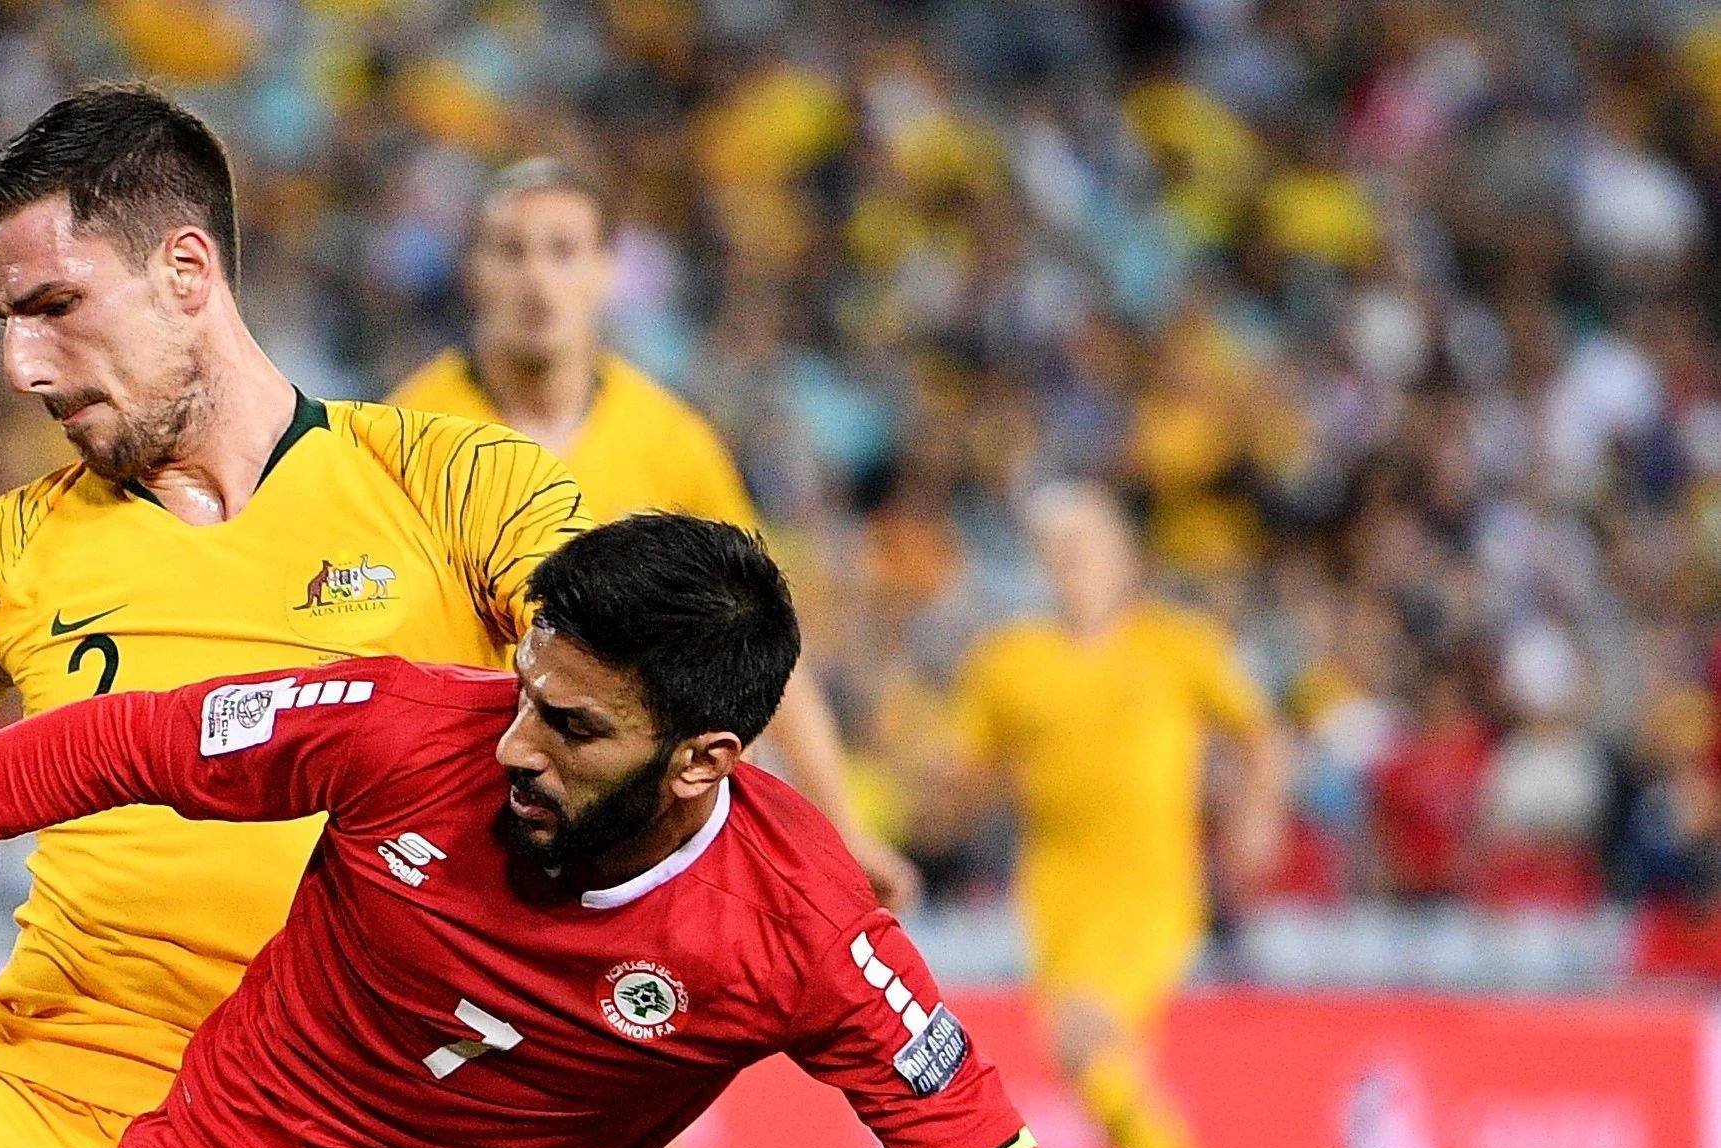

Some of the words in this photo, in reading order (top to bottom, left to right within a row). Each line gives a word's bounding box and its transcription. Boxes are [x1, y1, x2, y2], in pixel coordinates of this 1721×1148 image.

[310, 601, 386, 618] AUSTRALIA
[599, 998, 654, 1039] LEBANON
[422, 998, 525, 1081] 7
[907, 1044, 934, 1077] ONE
[927, 1017, 956, 1054] ASIA
[918, 1060, 944, 1093] ONE
